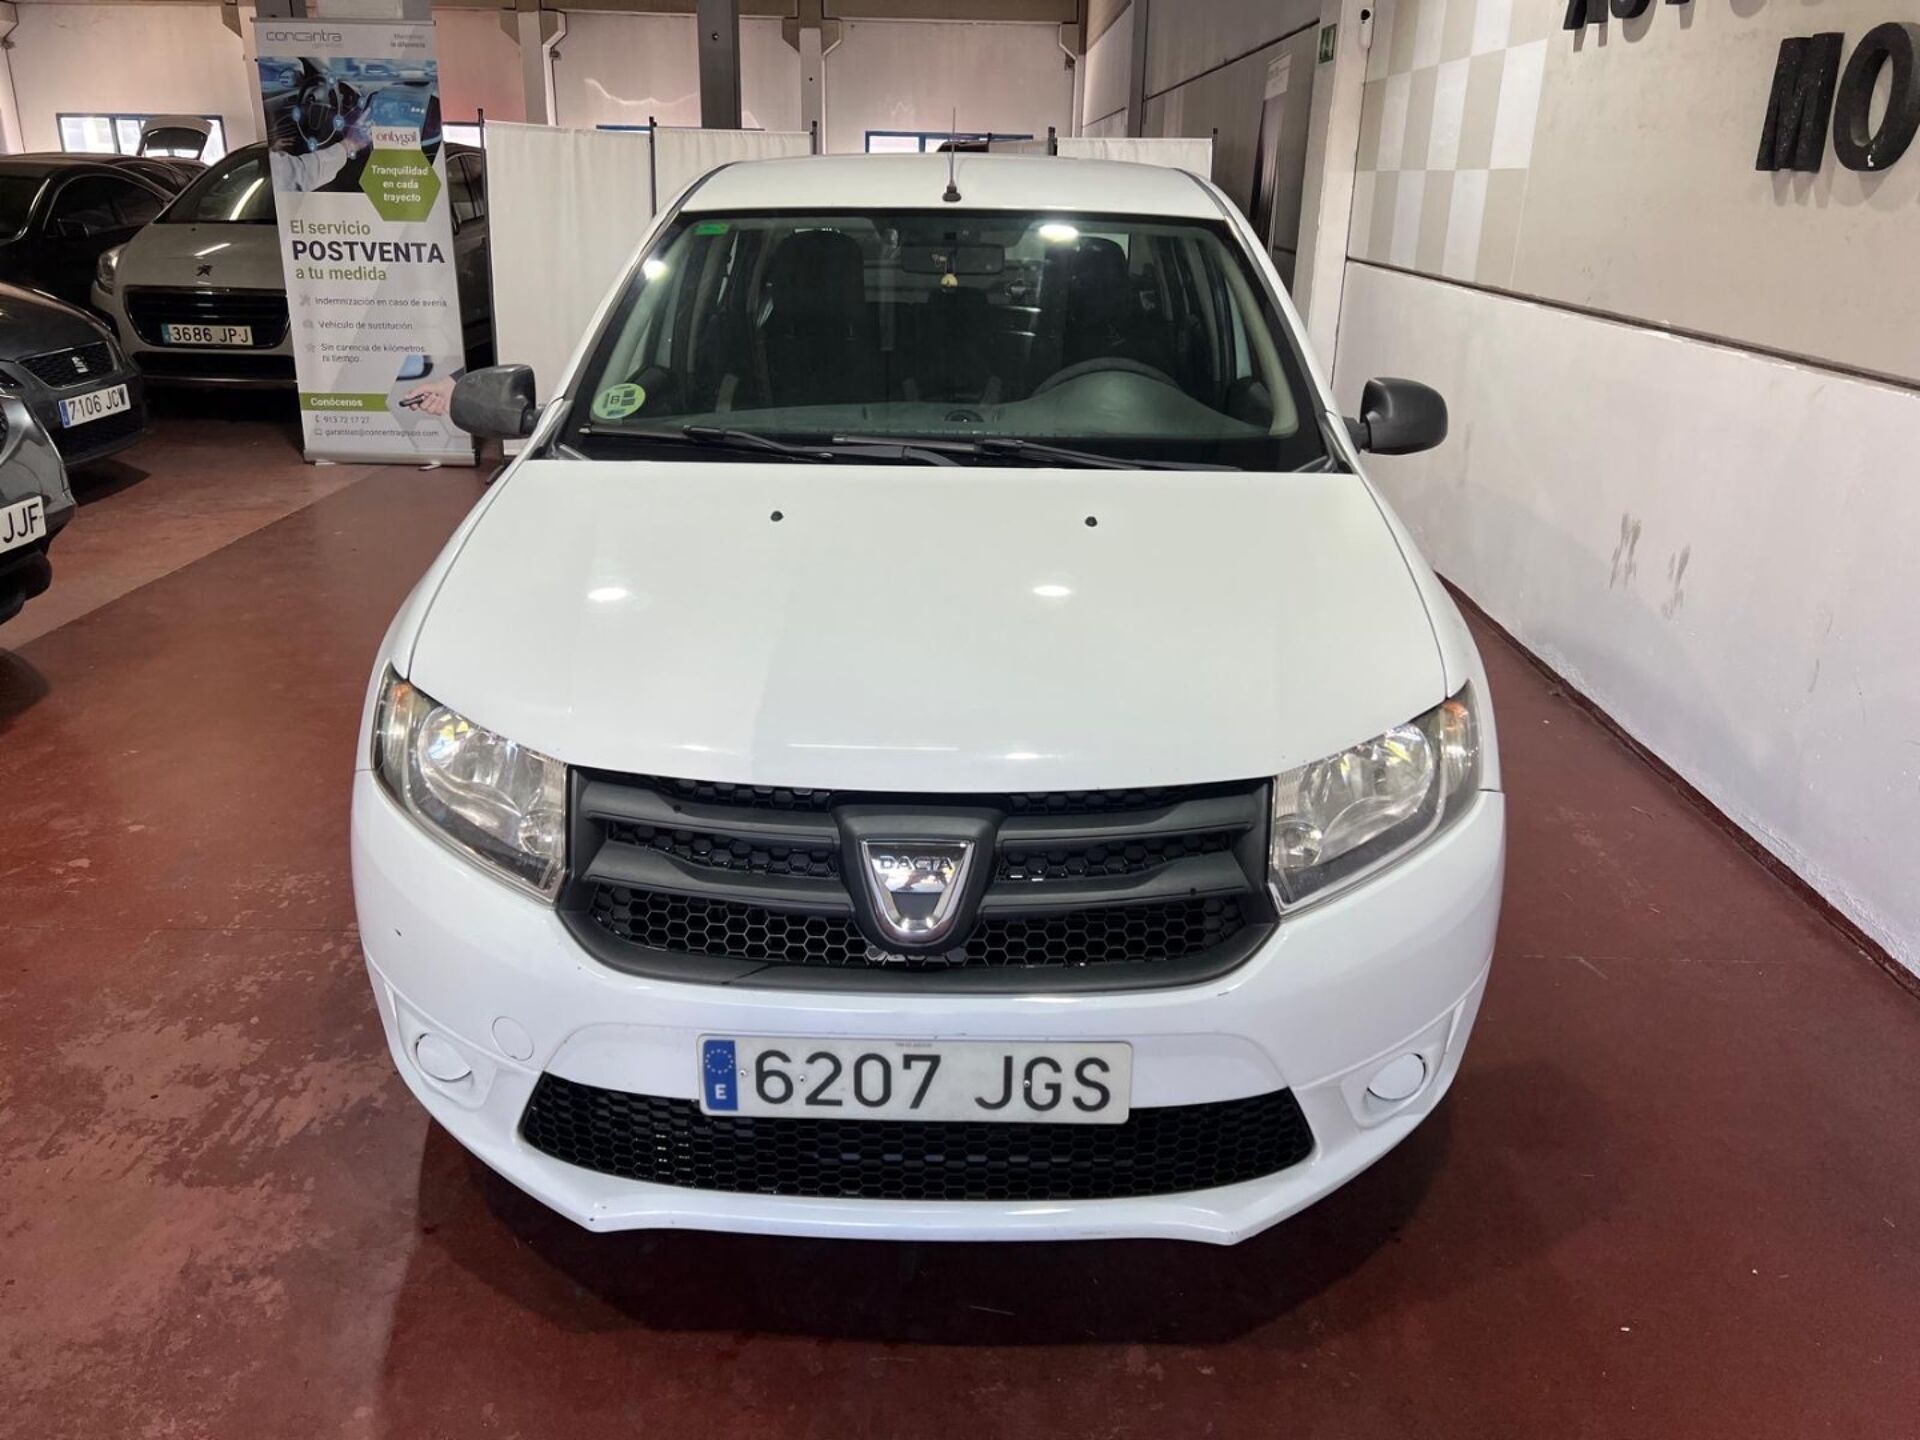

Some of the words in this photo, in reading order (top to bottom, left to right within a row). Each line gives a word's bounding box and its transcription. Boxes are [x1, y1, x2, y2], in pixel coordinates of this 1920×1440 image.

[371, 164, 429, 177] Tranquilidad
[383, 180, 394, 188] en
[396, 179, 419, 189] cada
[383, 193, 421, 203] trayecto
[290, 219, 304, 234] El
[308, 220, 371, 235] servicio
[292, 240, 445, 264] POSTVENTA
[296, 268, 305, 279] a
[309, 267, 324, 279] tu
[329, 266, 387, 281] medida
[410, 298, 420, 306] de
[356, 320, 366, 329] de
[172, 326, 213, 342] 3686
[219, 327, 249, 343] JPJ
[321, 343, 335, 352] Sin
[336, 344, 370, 352] carencia
[371, 343, 382, 352] de
[68, 395, 102, 420] 7106
[310, 397, 363, 407] Conócenos
[3, 503, 40, 543] JJF
[879, 854, 953, 871] DACIA
[714, 1084, 727, 1099] E
[754, 1049, 941, 1110] 6207
[975, 1054, 1111, 1112] JGS
